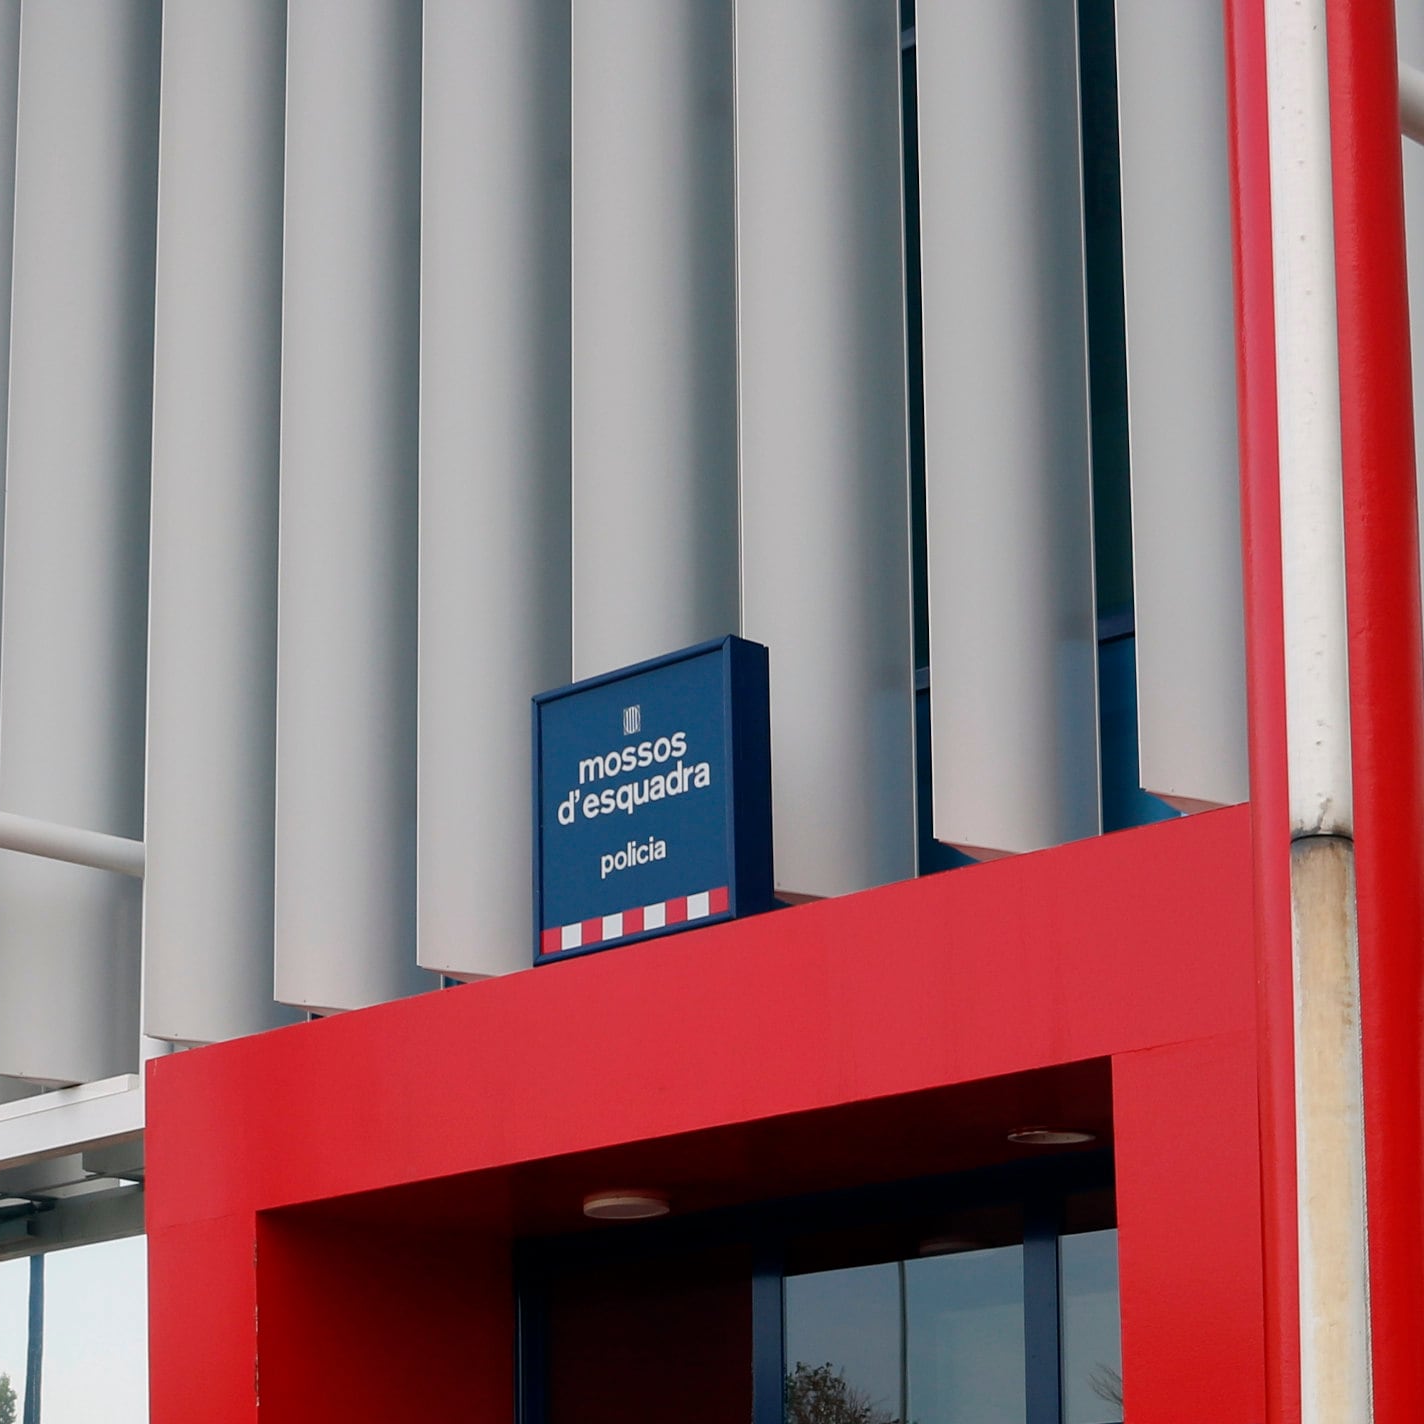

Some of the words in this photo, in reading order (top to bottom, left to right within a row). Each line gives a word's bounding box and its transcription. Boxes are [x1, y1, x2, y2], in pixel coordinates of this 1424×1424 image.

[579, 731, 687, 784] mossos
[557, 760, 711, 826] d'esquadra
[600, 836, 667, 879] policia
